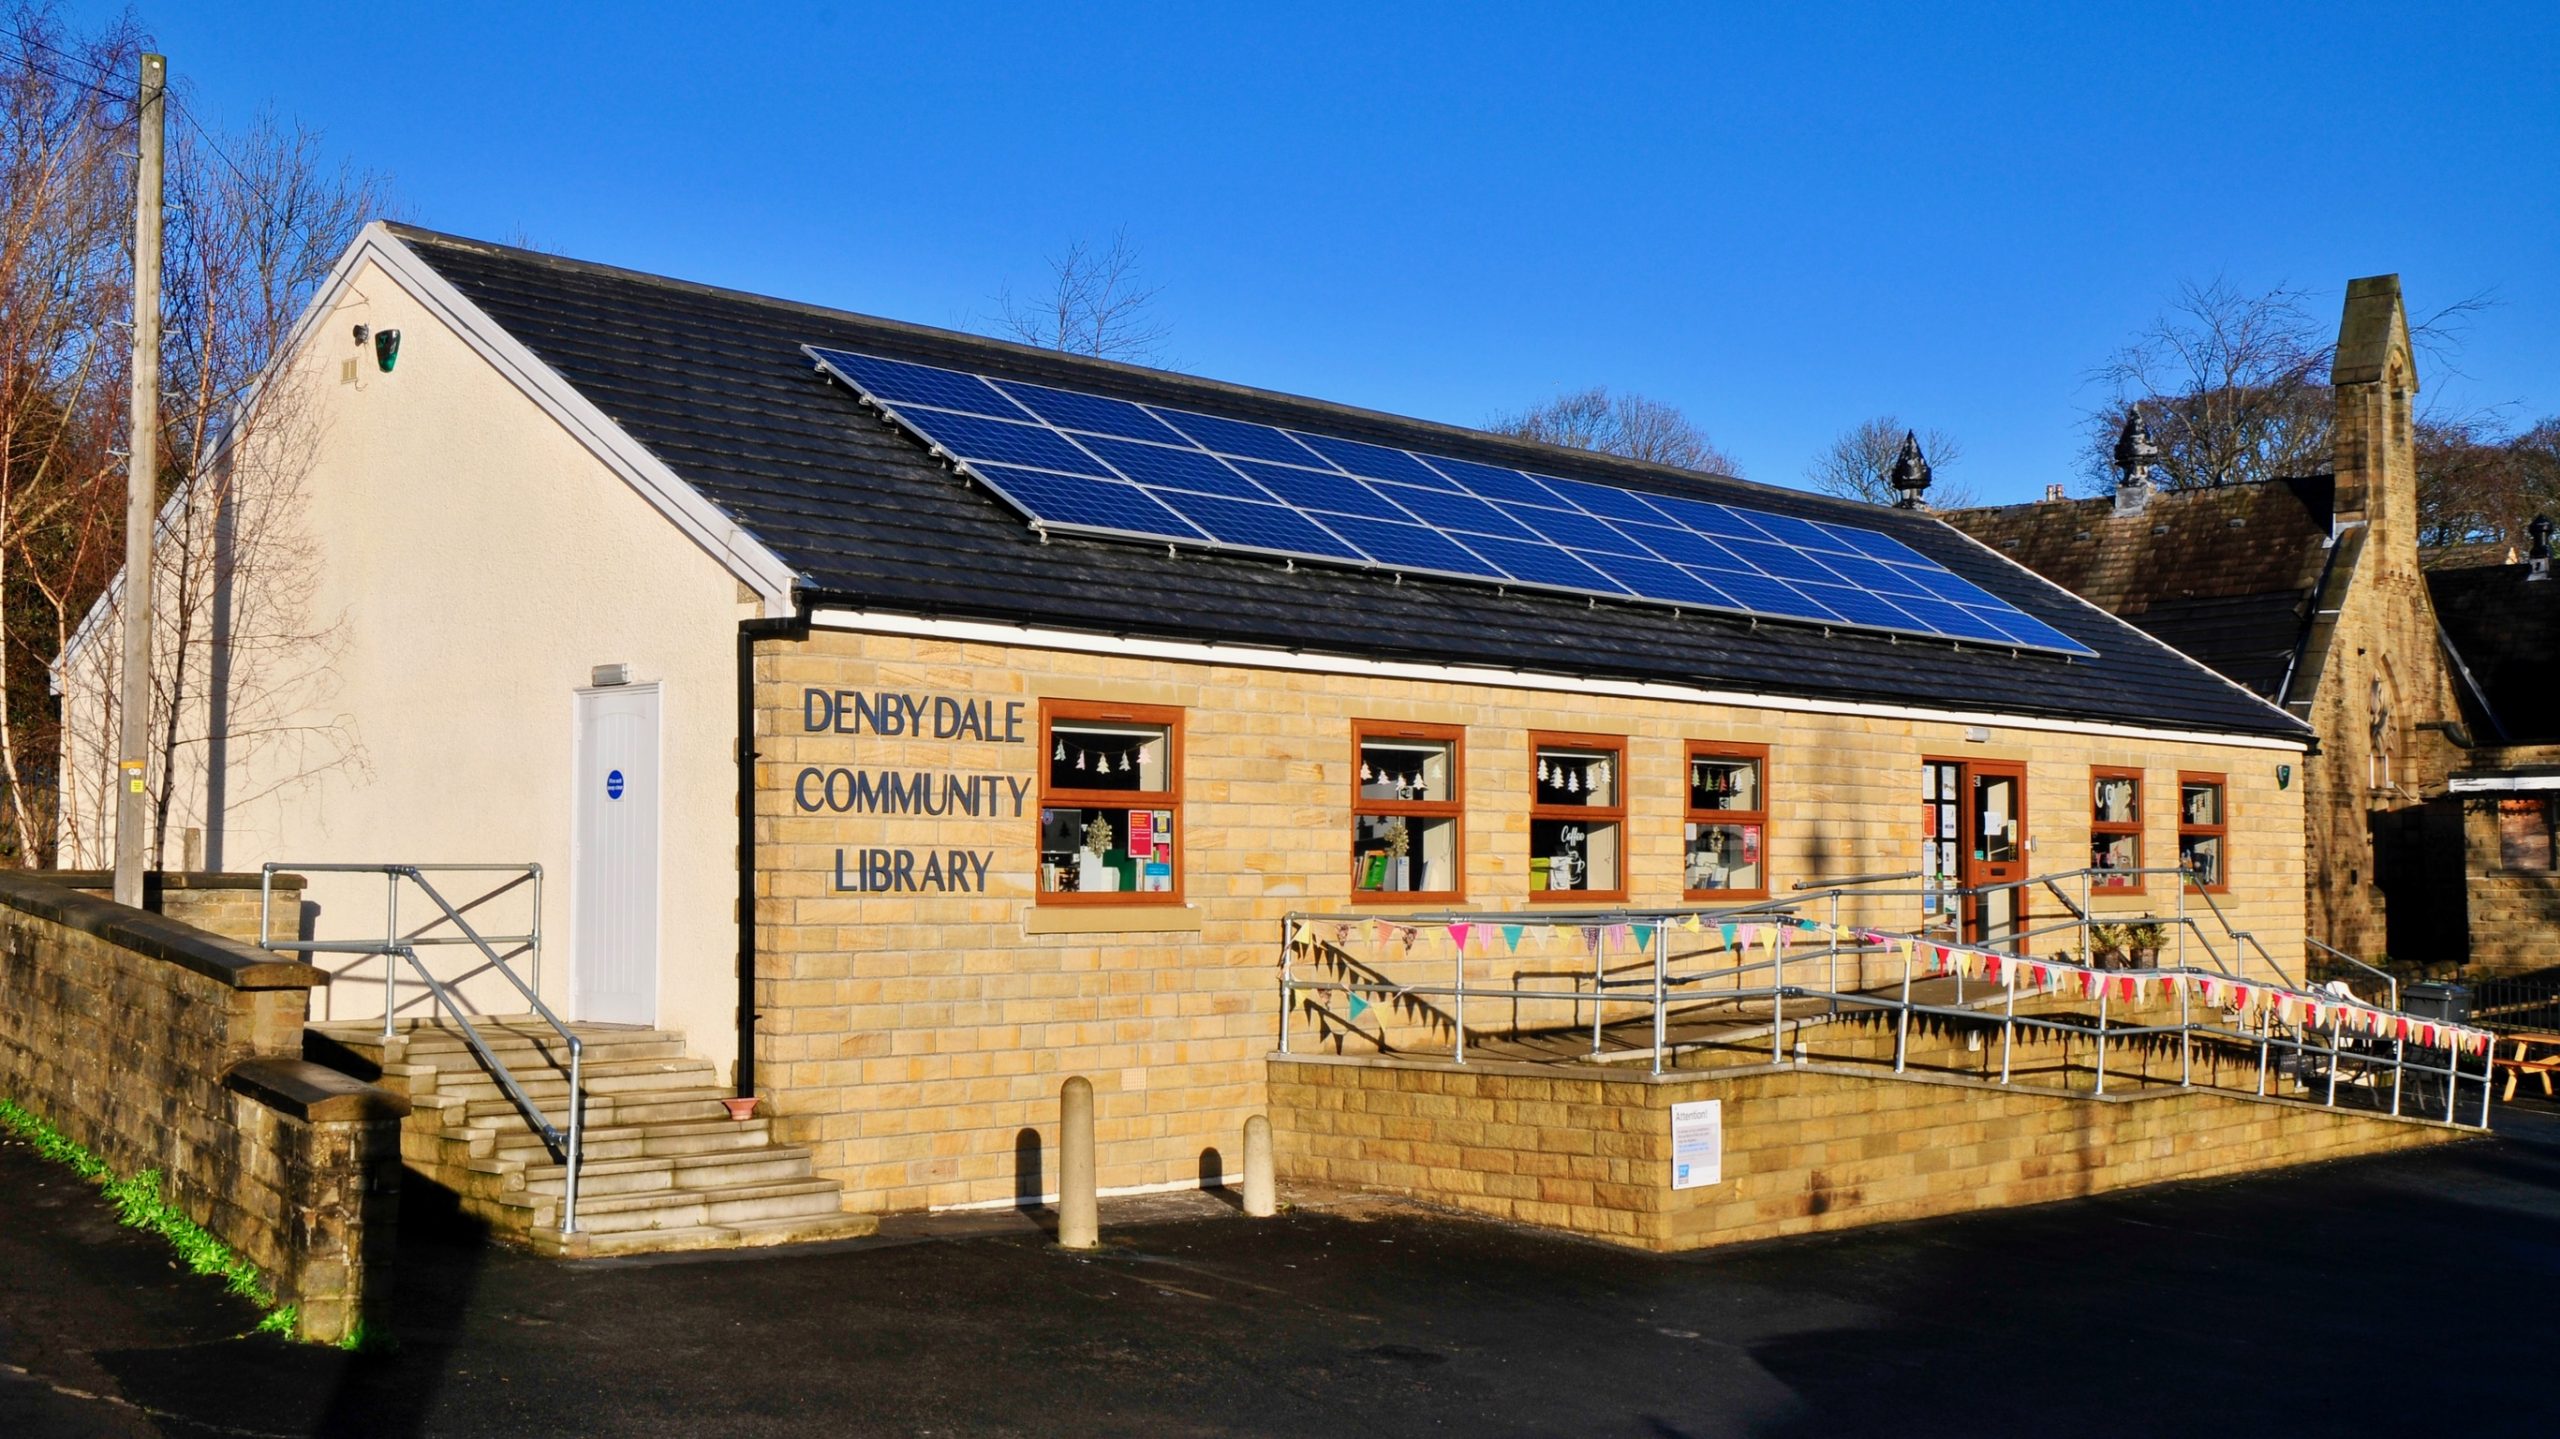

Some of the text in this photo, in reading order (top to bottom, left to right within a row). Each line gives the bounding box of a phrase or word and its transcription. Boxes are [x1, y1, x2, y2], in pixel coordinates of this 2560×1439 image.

[804, 688, 1025, 743] DENBY DALE
[795, 767, 1032, 817] COMMUNITY
[835, 848, 994, 893] LIBRARY
